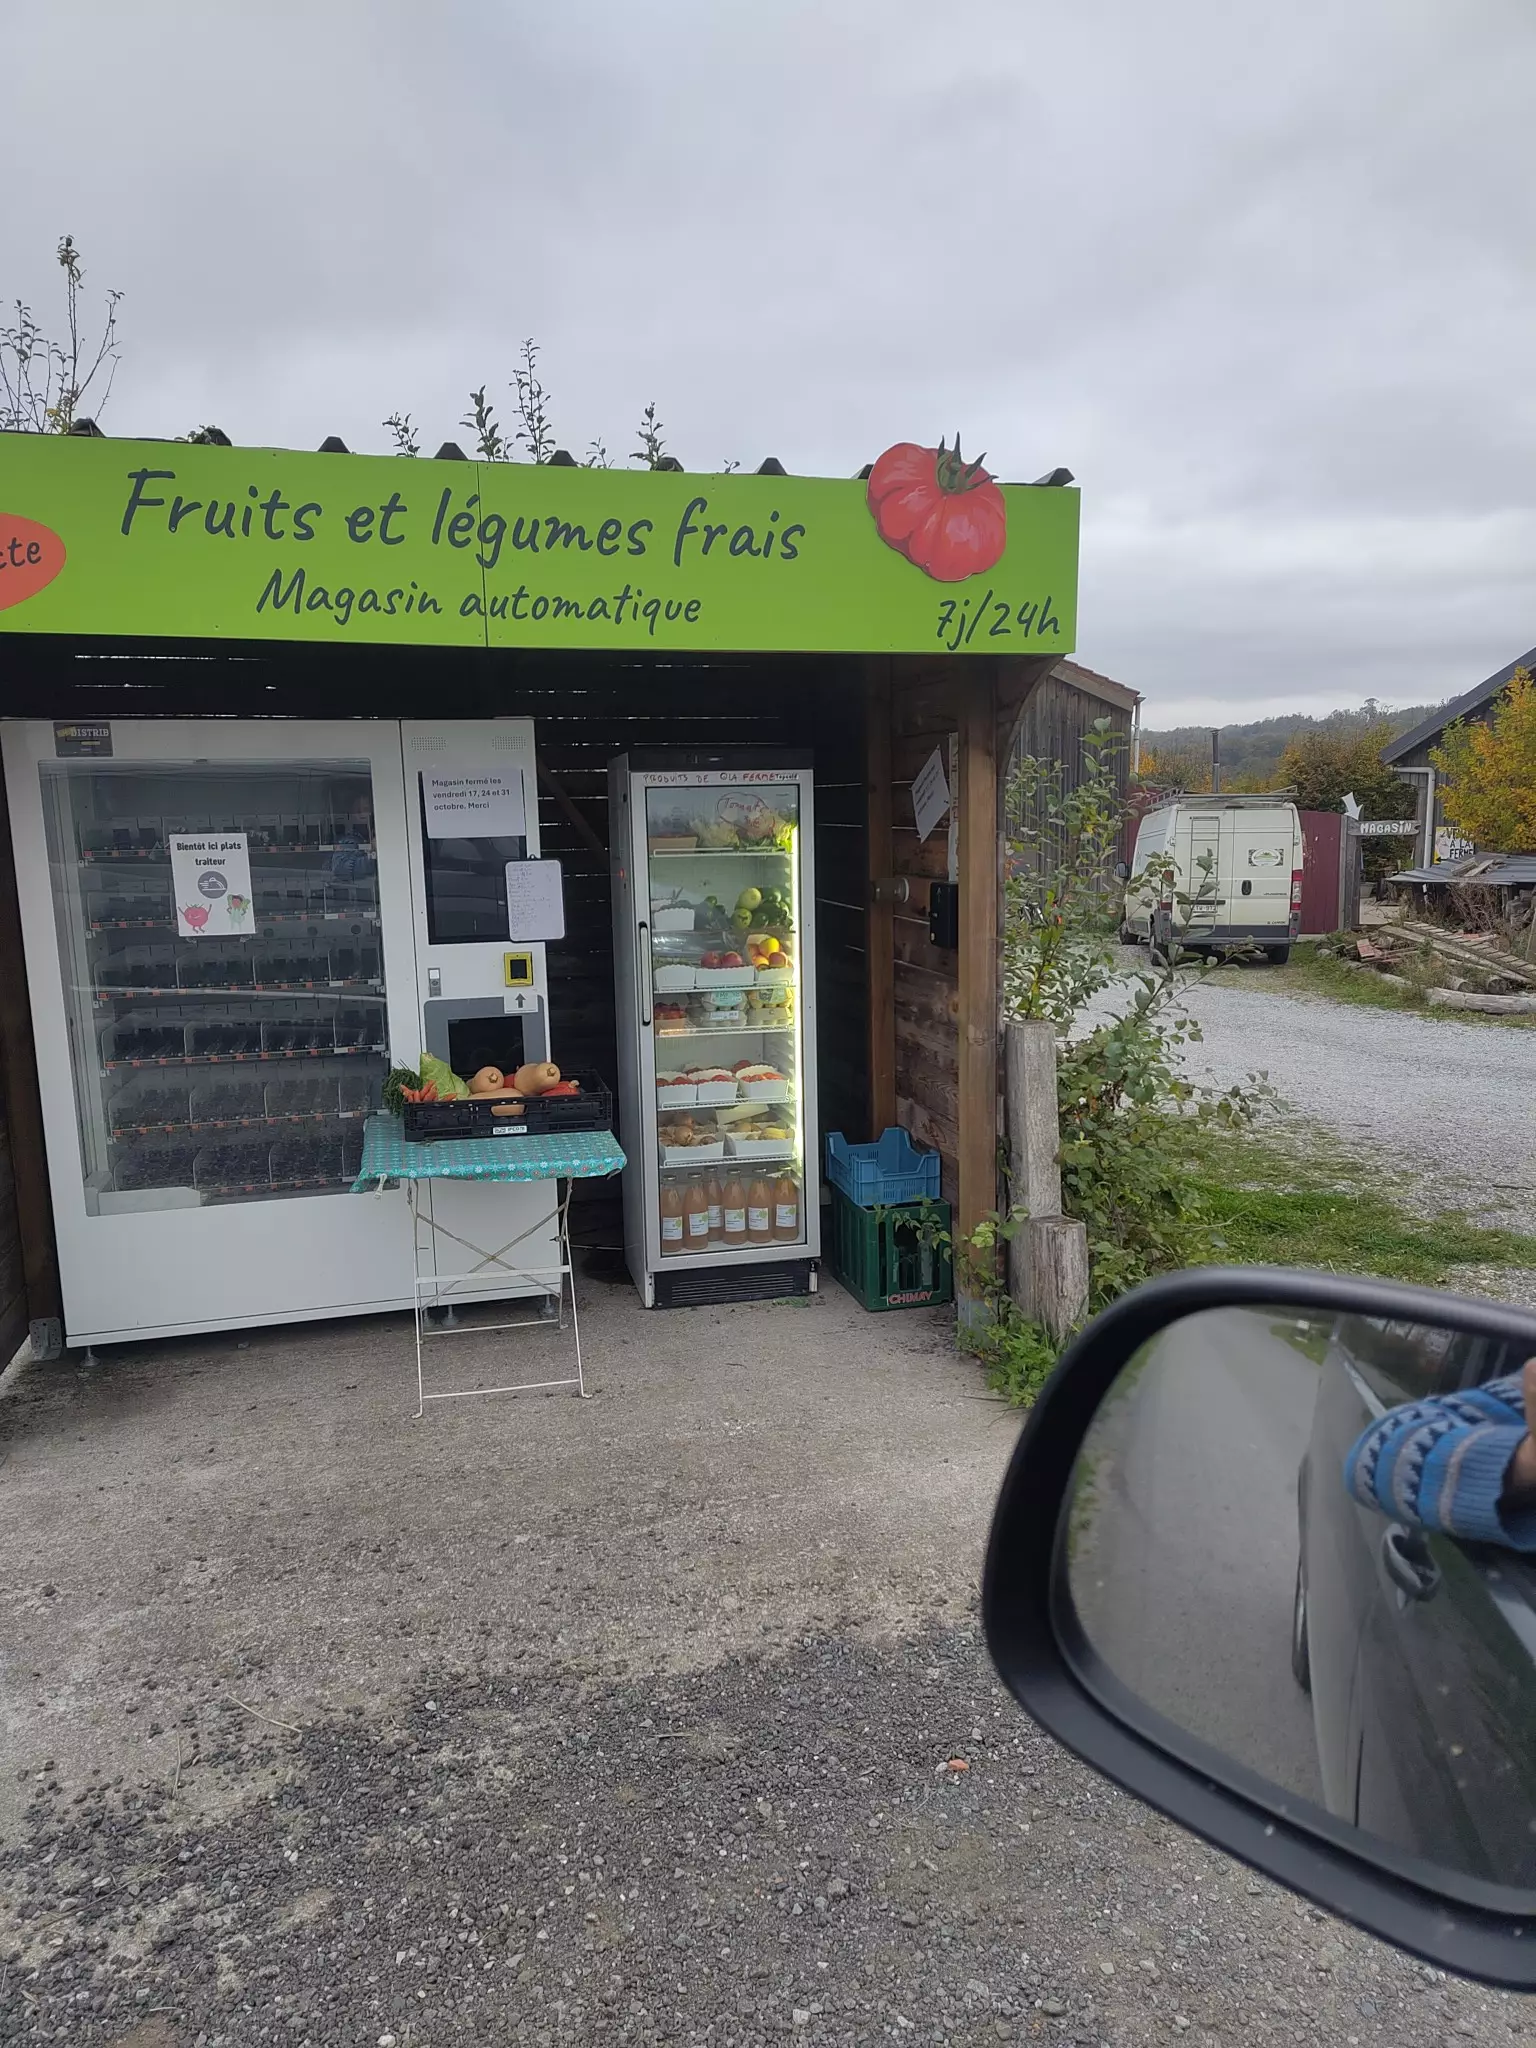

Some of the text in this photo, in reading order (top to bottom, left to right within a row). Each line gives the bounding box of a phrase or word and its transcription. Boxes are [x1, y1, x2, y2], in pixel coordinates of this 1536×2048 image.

[121, 468, 806, 569] Fruits et légumes frais
[256, 568, 702, 636] Magasin automatique
[936, 590, 1060, 651] 7j/24h
[743, 773, 775, 782] FERME
[432, 779, 464, 787] Magasin
[433, 791, 467, 799] vendredi
[469, 790, 480, 798] 17,
[481, 789, 490, 797] 24
[434, 801, 490, 811] octobre. Merci
[1361, 821, 1412, 833] MAGASIN
[176, 841, 242, 851] Bientôt ici plats
[195, 857, 226, 866] traiteur
[889, 1291, 933, 1304] CHIMAY
